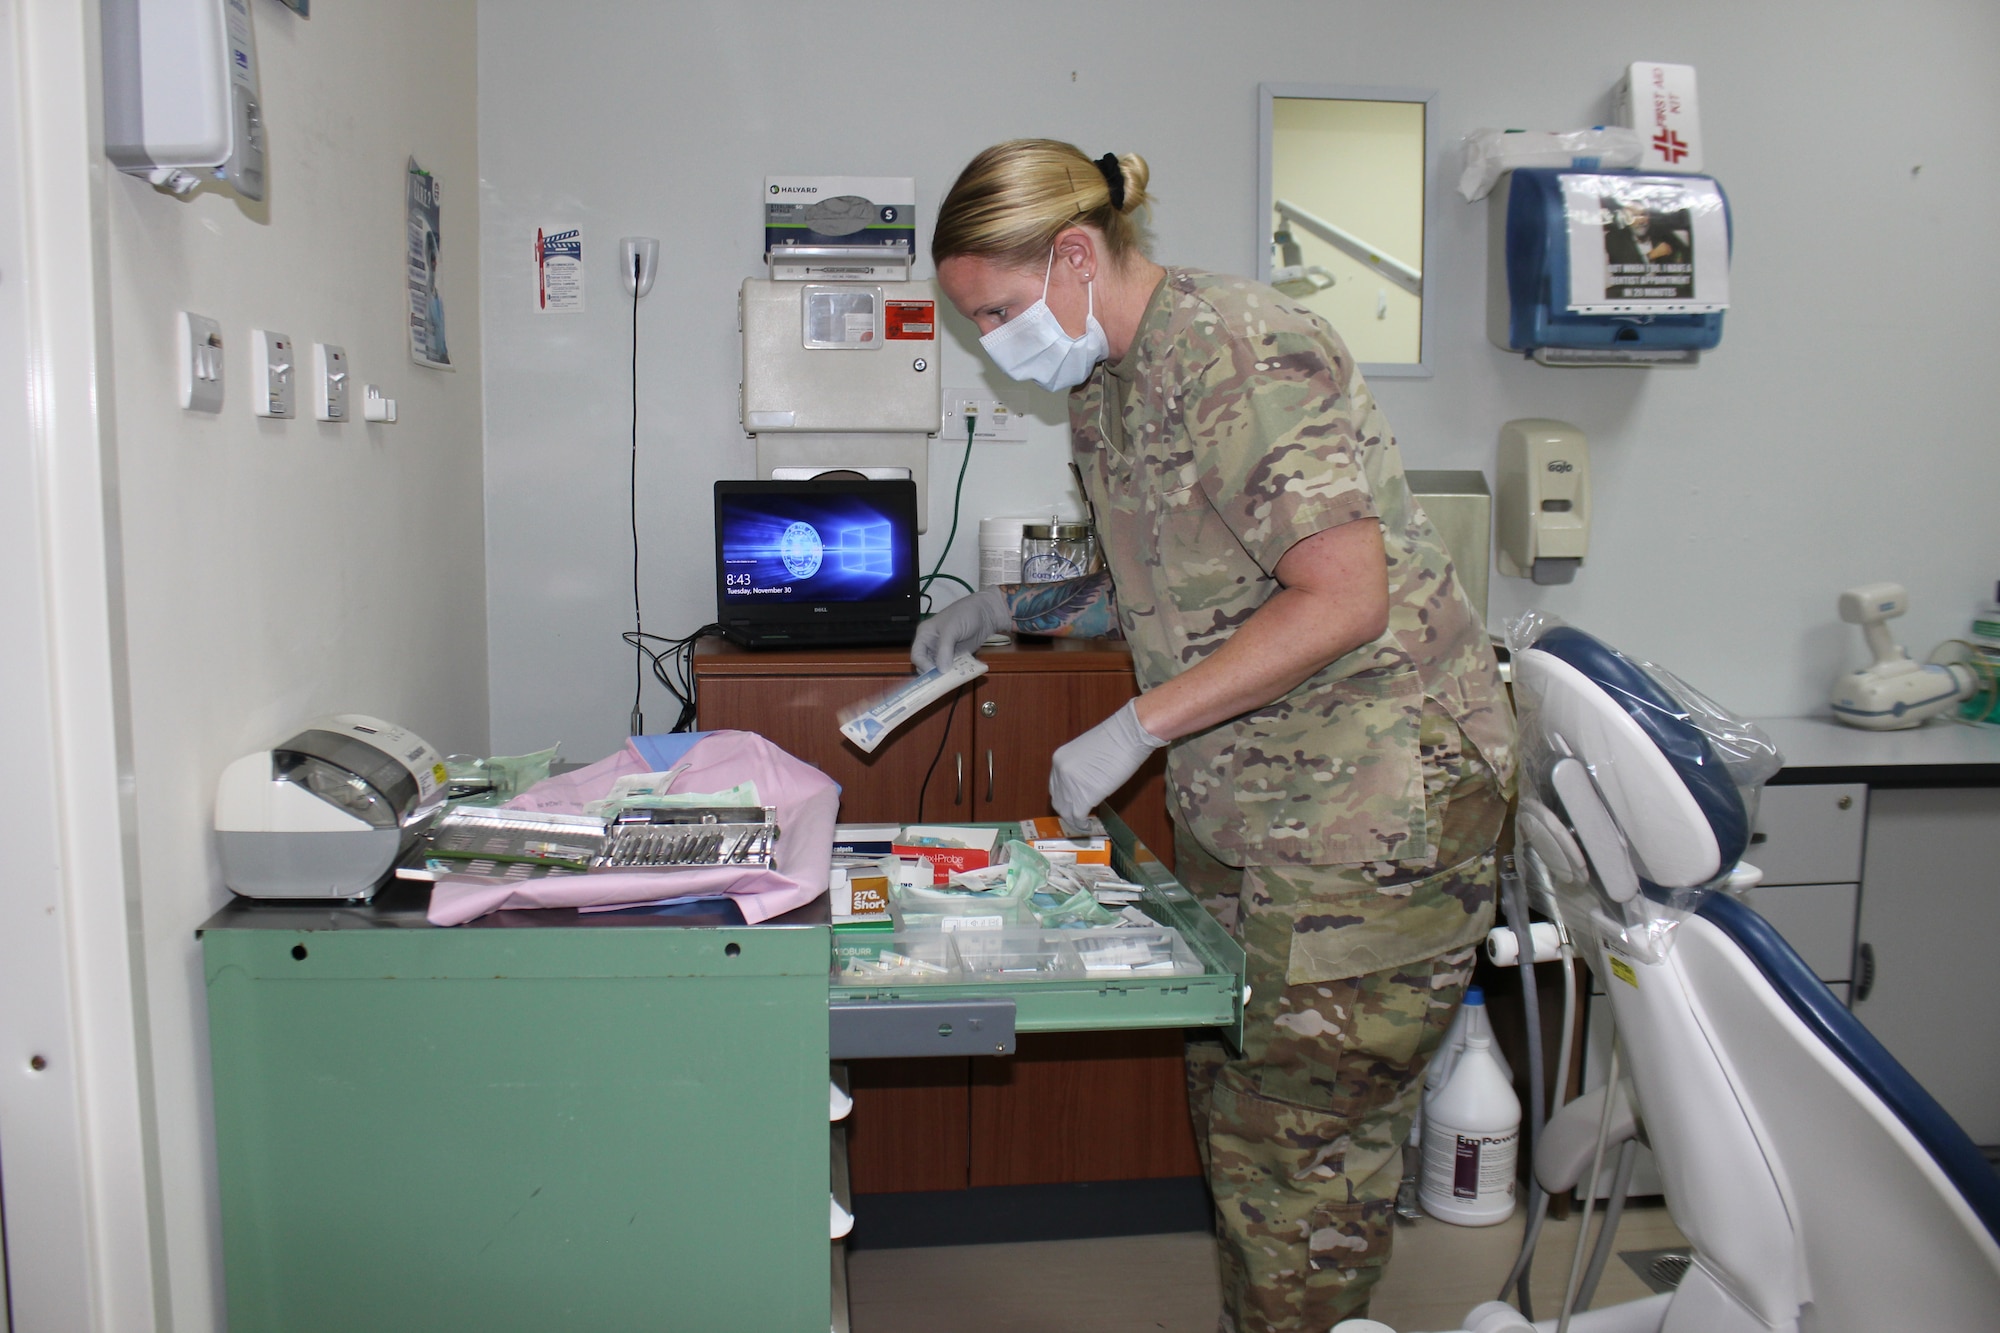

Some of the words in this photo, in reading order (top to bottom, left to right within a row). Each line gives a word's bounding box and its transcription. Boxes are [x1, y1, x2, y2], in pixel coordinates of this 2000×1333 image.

[1652, 67, 1663, 89] AID
[1668, 93, 1681, 113] KIT
[1653, 93, 1666, 128] FIRST
[885, 209, 893, 220] S
[726, 573, 751, 586] 8:43
[1032, 572, 1066, 580] COTTON
[833, 845, 854, 854] calpels
[853, 889, 880, 901] 27G.
[853, 899, 886, 910] Short
